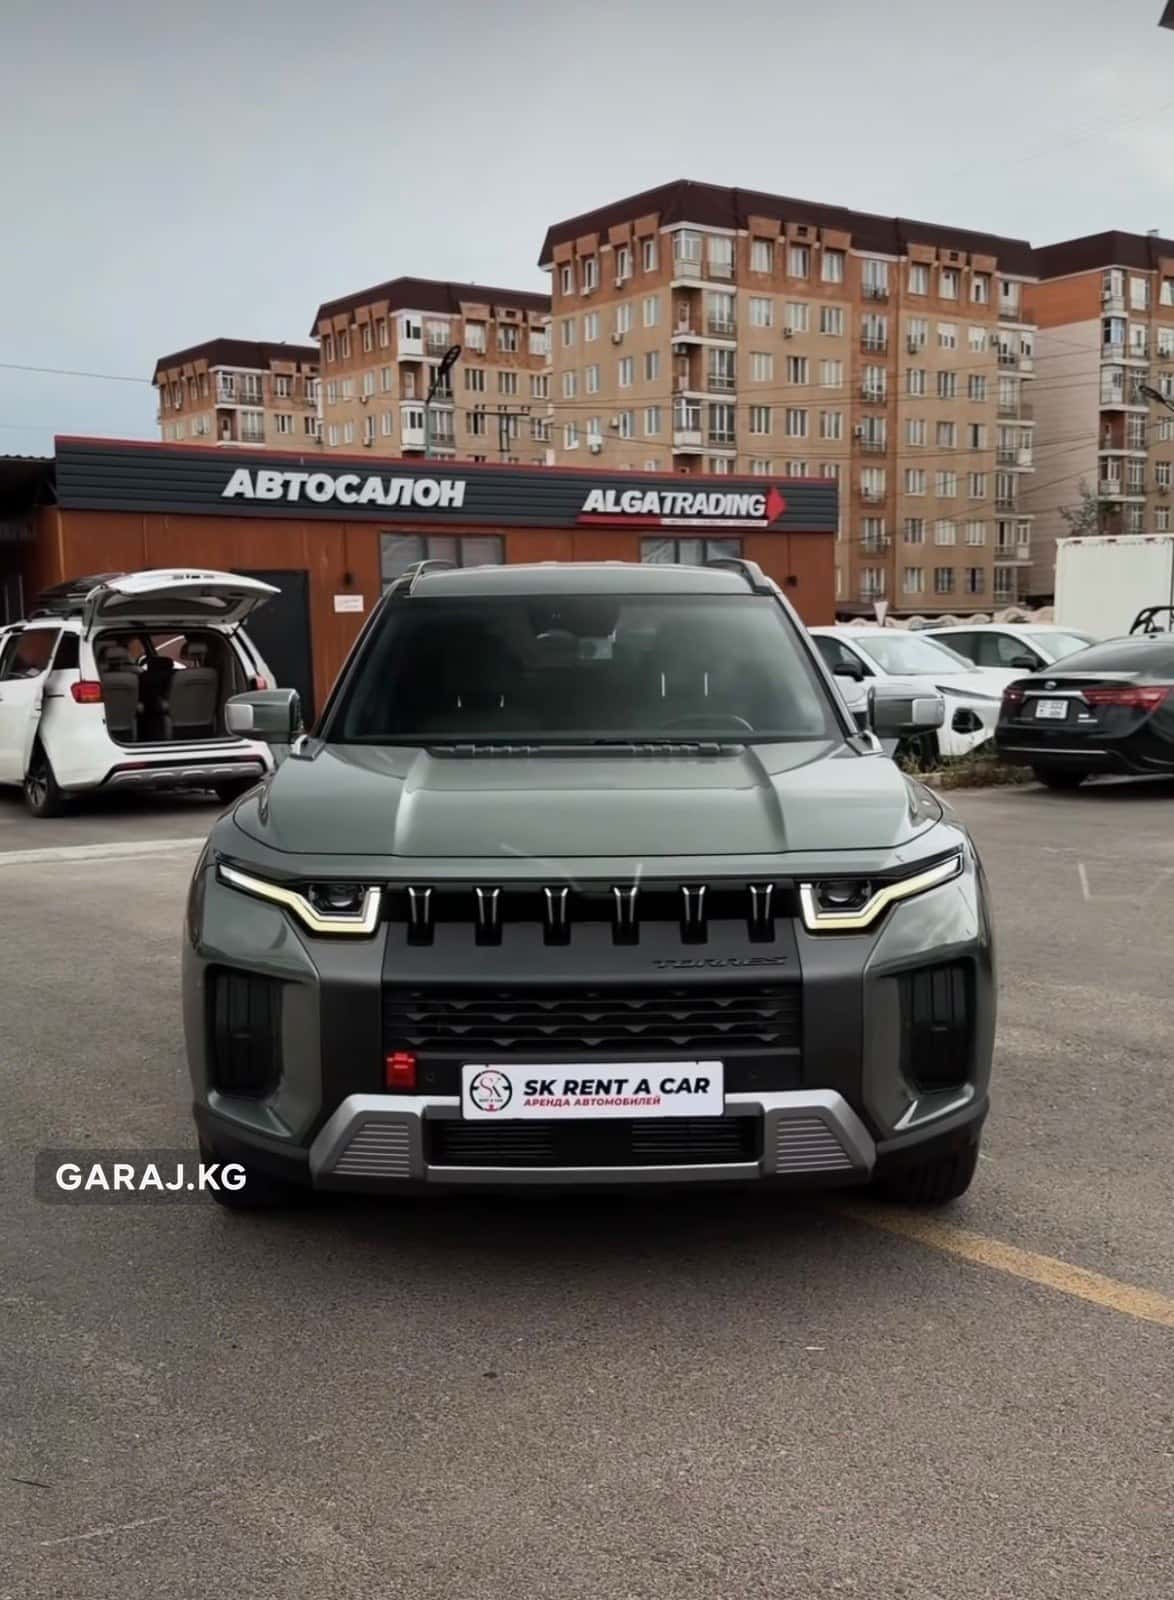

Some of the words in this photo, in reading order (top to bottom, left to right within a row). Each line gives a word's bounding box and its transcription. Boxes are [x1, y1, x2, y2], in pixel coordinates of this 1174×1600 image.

[221, 468, 466, 508] АВТОСАЛОН
[652, 956, 787, 969] TORRES
[523, 1079, 557, 1096] SK
[563, 1078, 629, 1096] RENT
[634, 1078, 652, 1095] A
[659, 1077, 711, 1095] CAR
[523, 1097, 571, 1108] АРЕНДА
[574, 1094, 662, 1107] АВТОМОБИЛЕЙ
